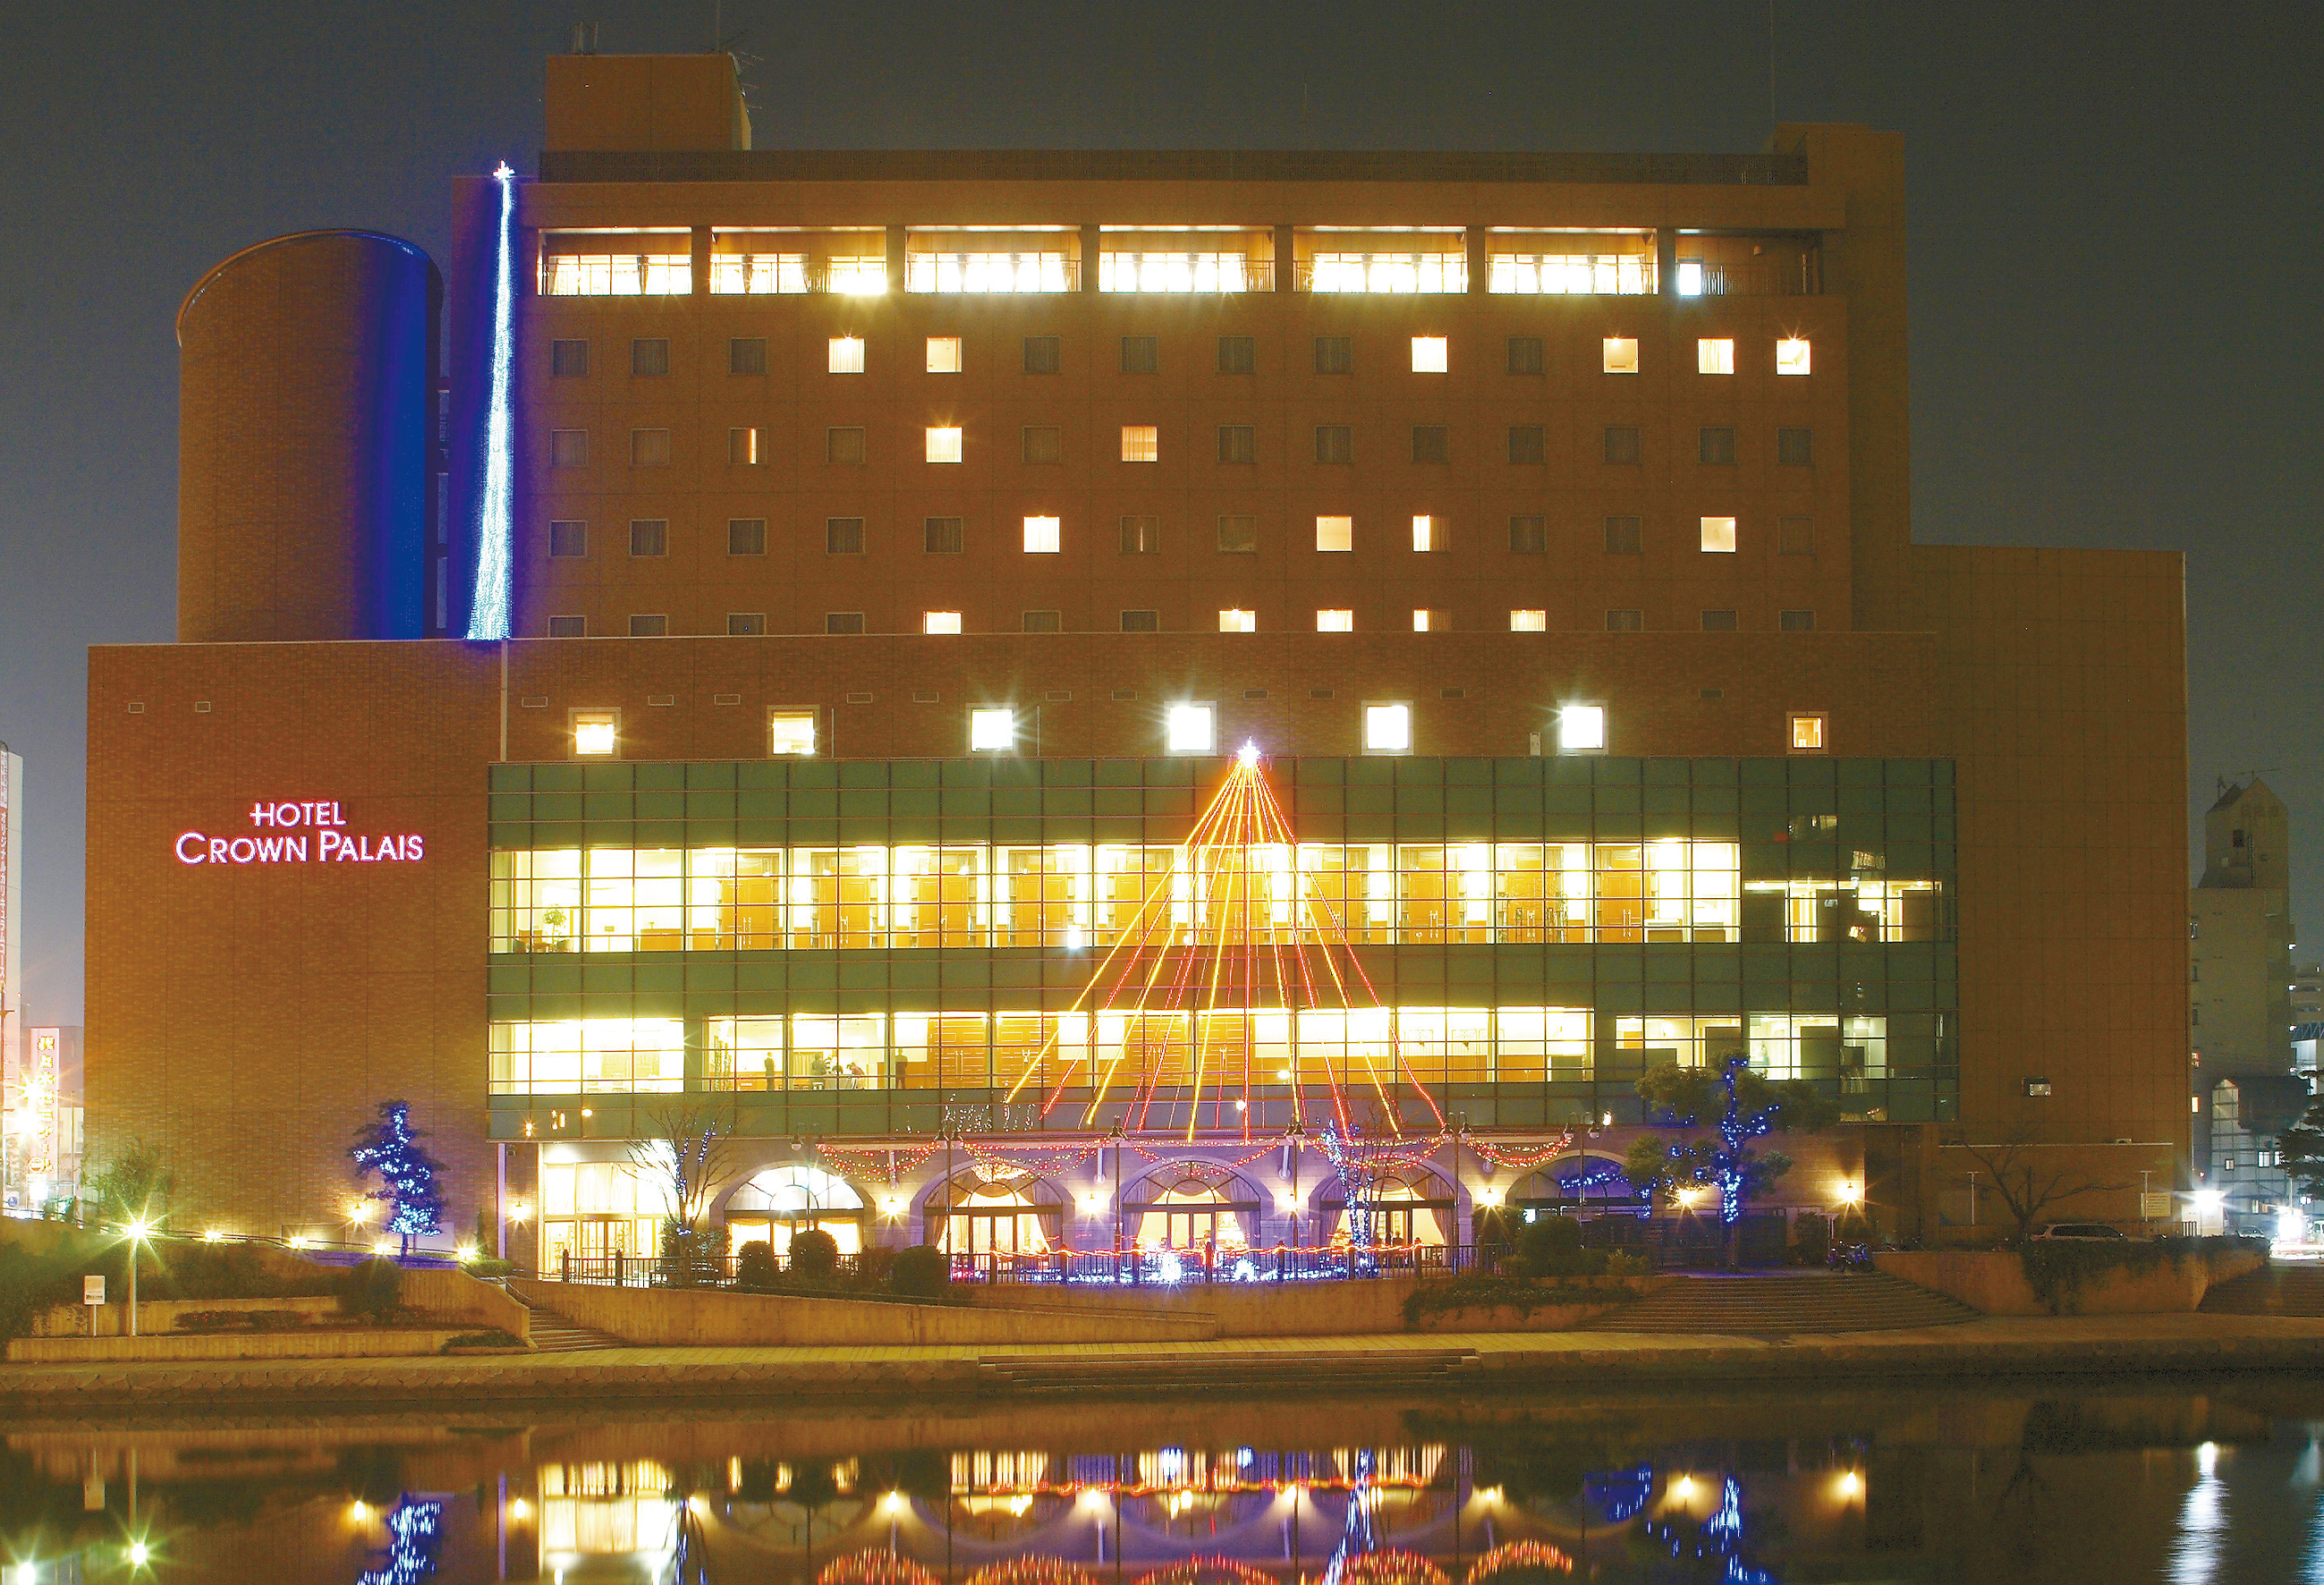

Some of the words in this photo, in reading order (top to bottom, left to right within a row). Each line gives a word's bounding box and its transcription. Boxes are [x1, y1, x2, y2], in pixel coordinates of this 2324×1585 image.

[250, 801, 347, 827] HOTEL
[174, 831, 308, 865] CROWN
[318, 829, 425, 863] PALAIS
